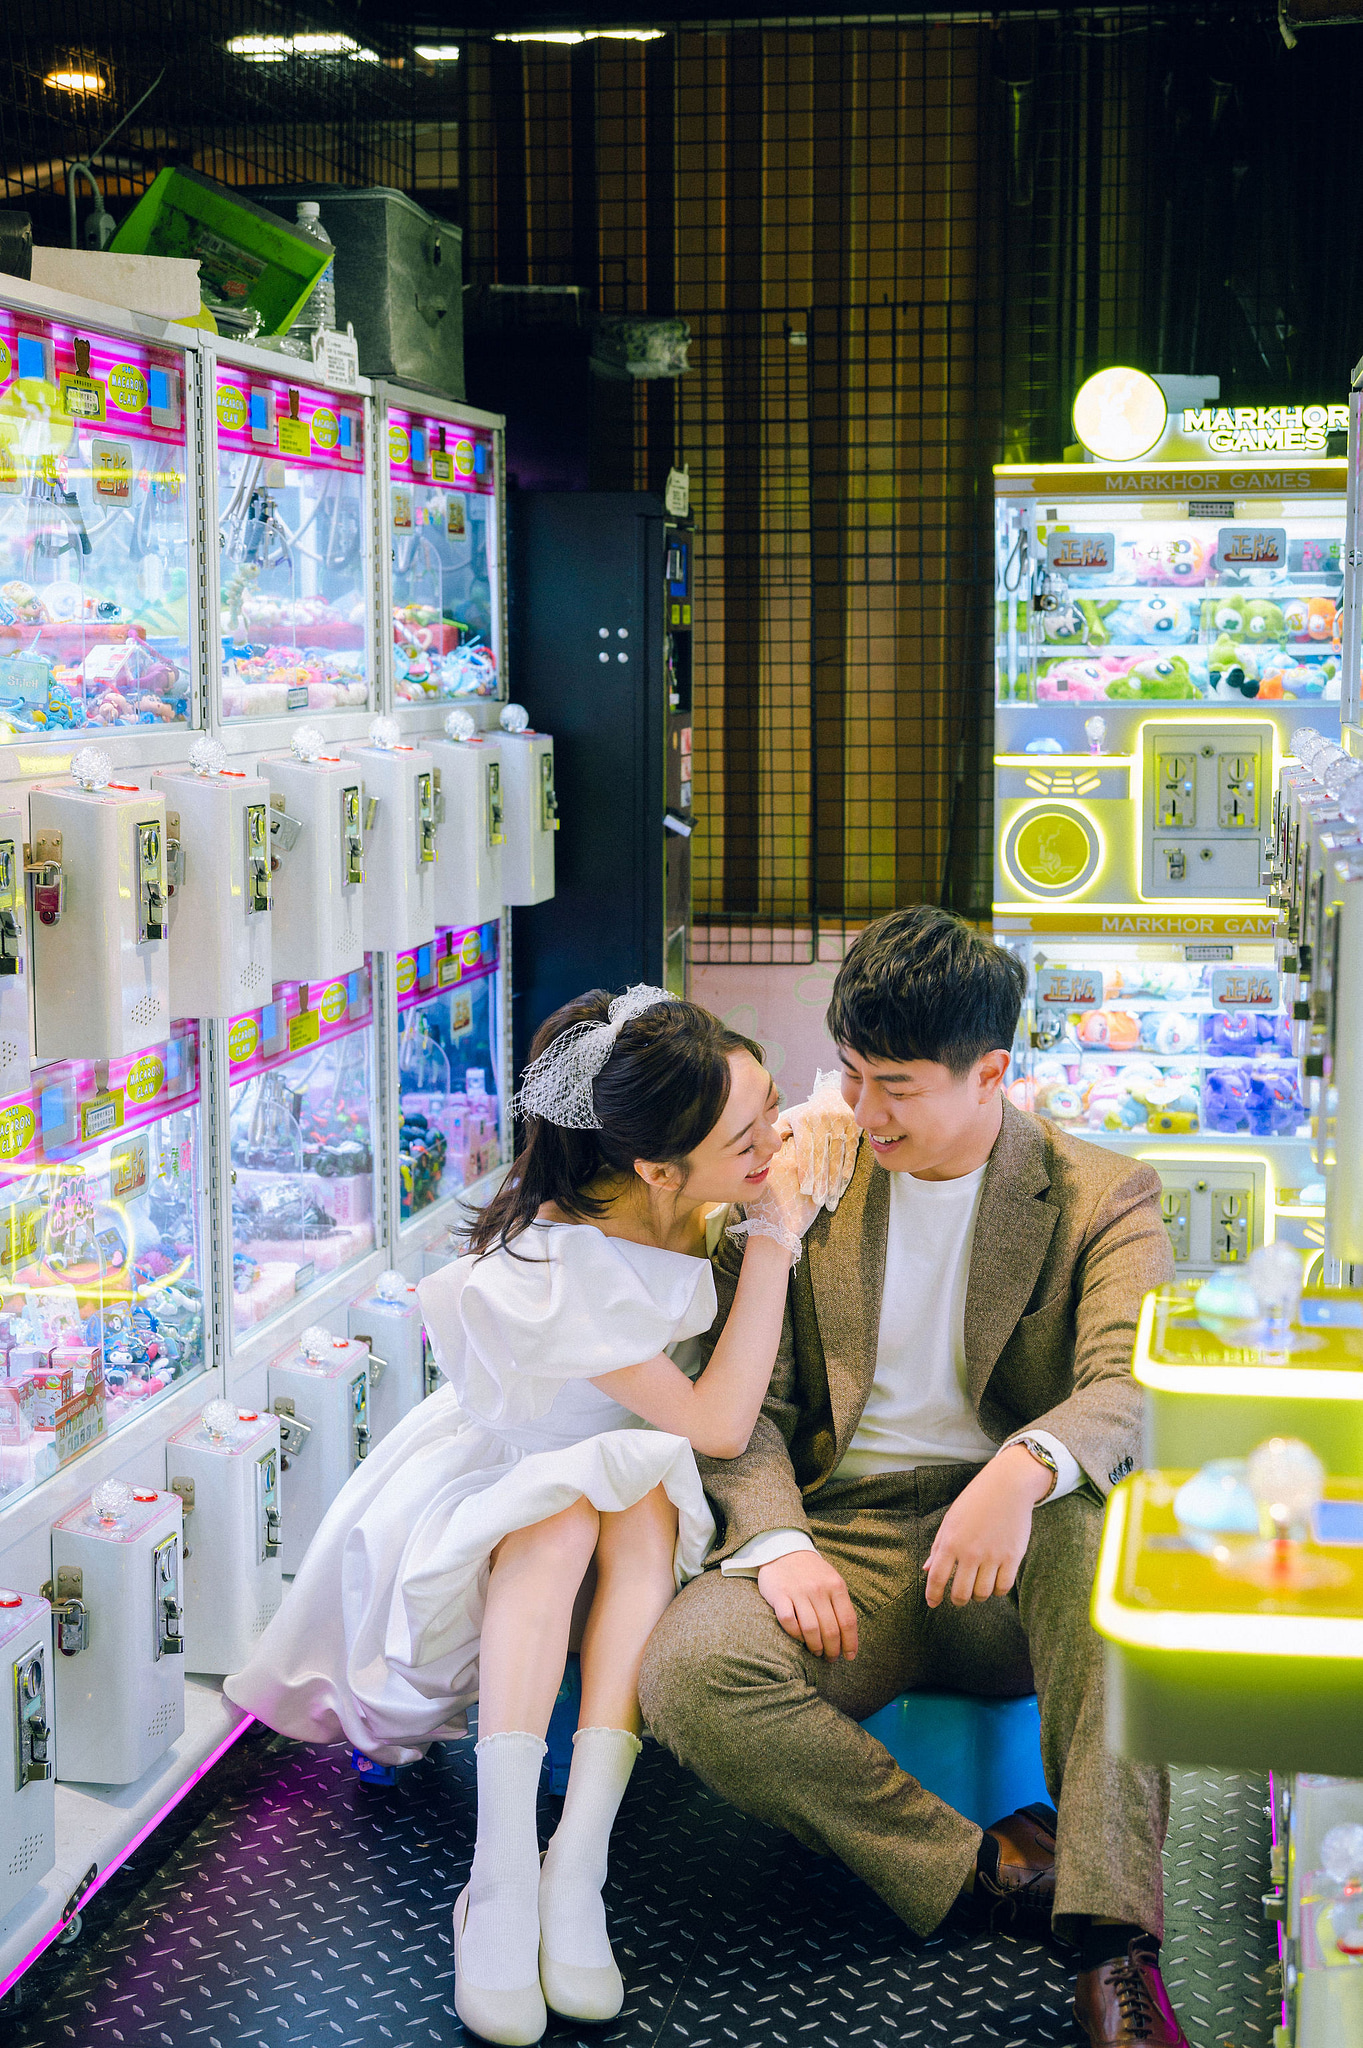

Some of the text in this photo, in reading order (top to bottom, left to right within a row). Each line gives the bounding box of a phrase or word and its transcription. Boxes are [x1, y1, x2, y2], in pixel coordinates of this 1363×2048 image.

[111, 374, 144, 394] MACARON
[118, 391, 138, 408] CLAW
[223, 411, 239, 425] CLAW
[1183, 404, 1350, 432] MARKHOR
[1208, 427, 1328, 453] GAMES
[1105, 472, 1311, 491] MARKHOR GAMES
[1053, 539, 1108, 568] 正版
[1223, 534, 1279, 563] 正版
[1102, 916, 1214, 933] MARKHOR
[1044, 975, 1096, 1003] 正版
[1219, 975, 1273, 1004] 正版
[129, 1067, 161, 1085] MACARON
[136, 1081, 154, 1099] CLAW
[0, 1113, 32, 1138] ACARON
[1, 1133, 24, 1154] CLAW
